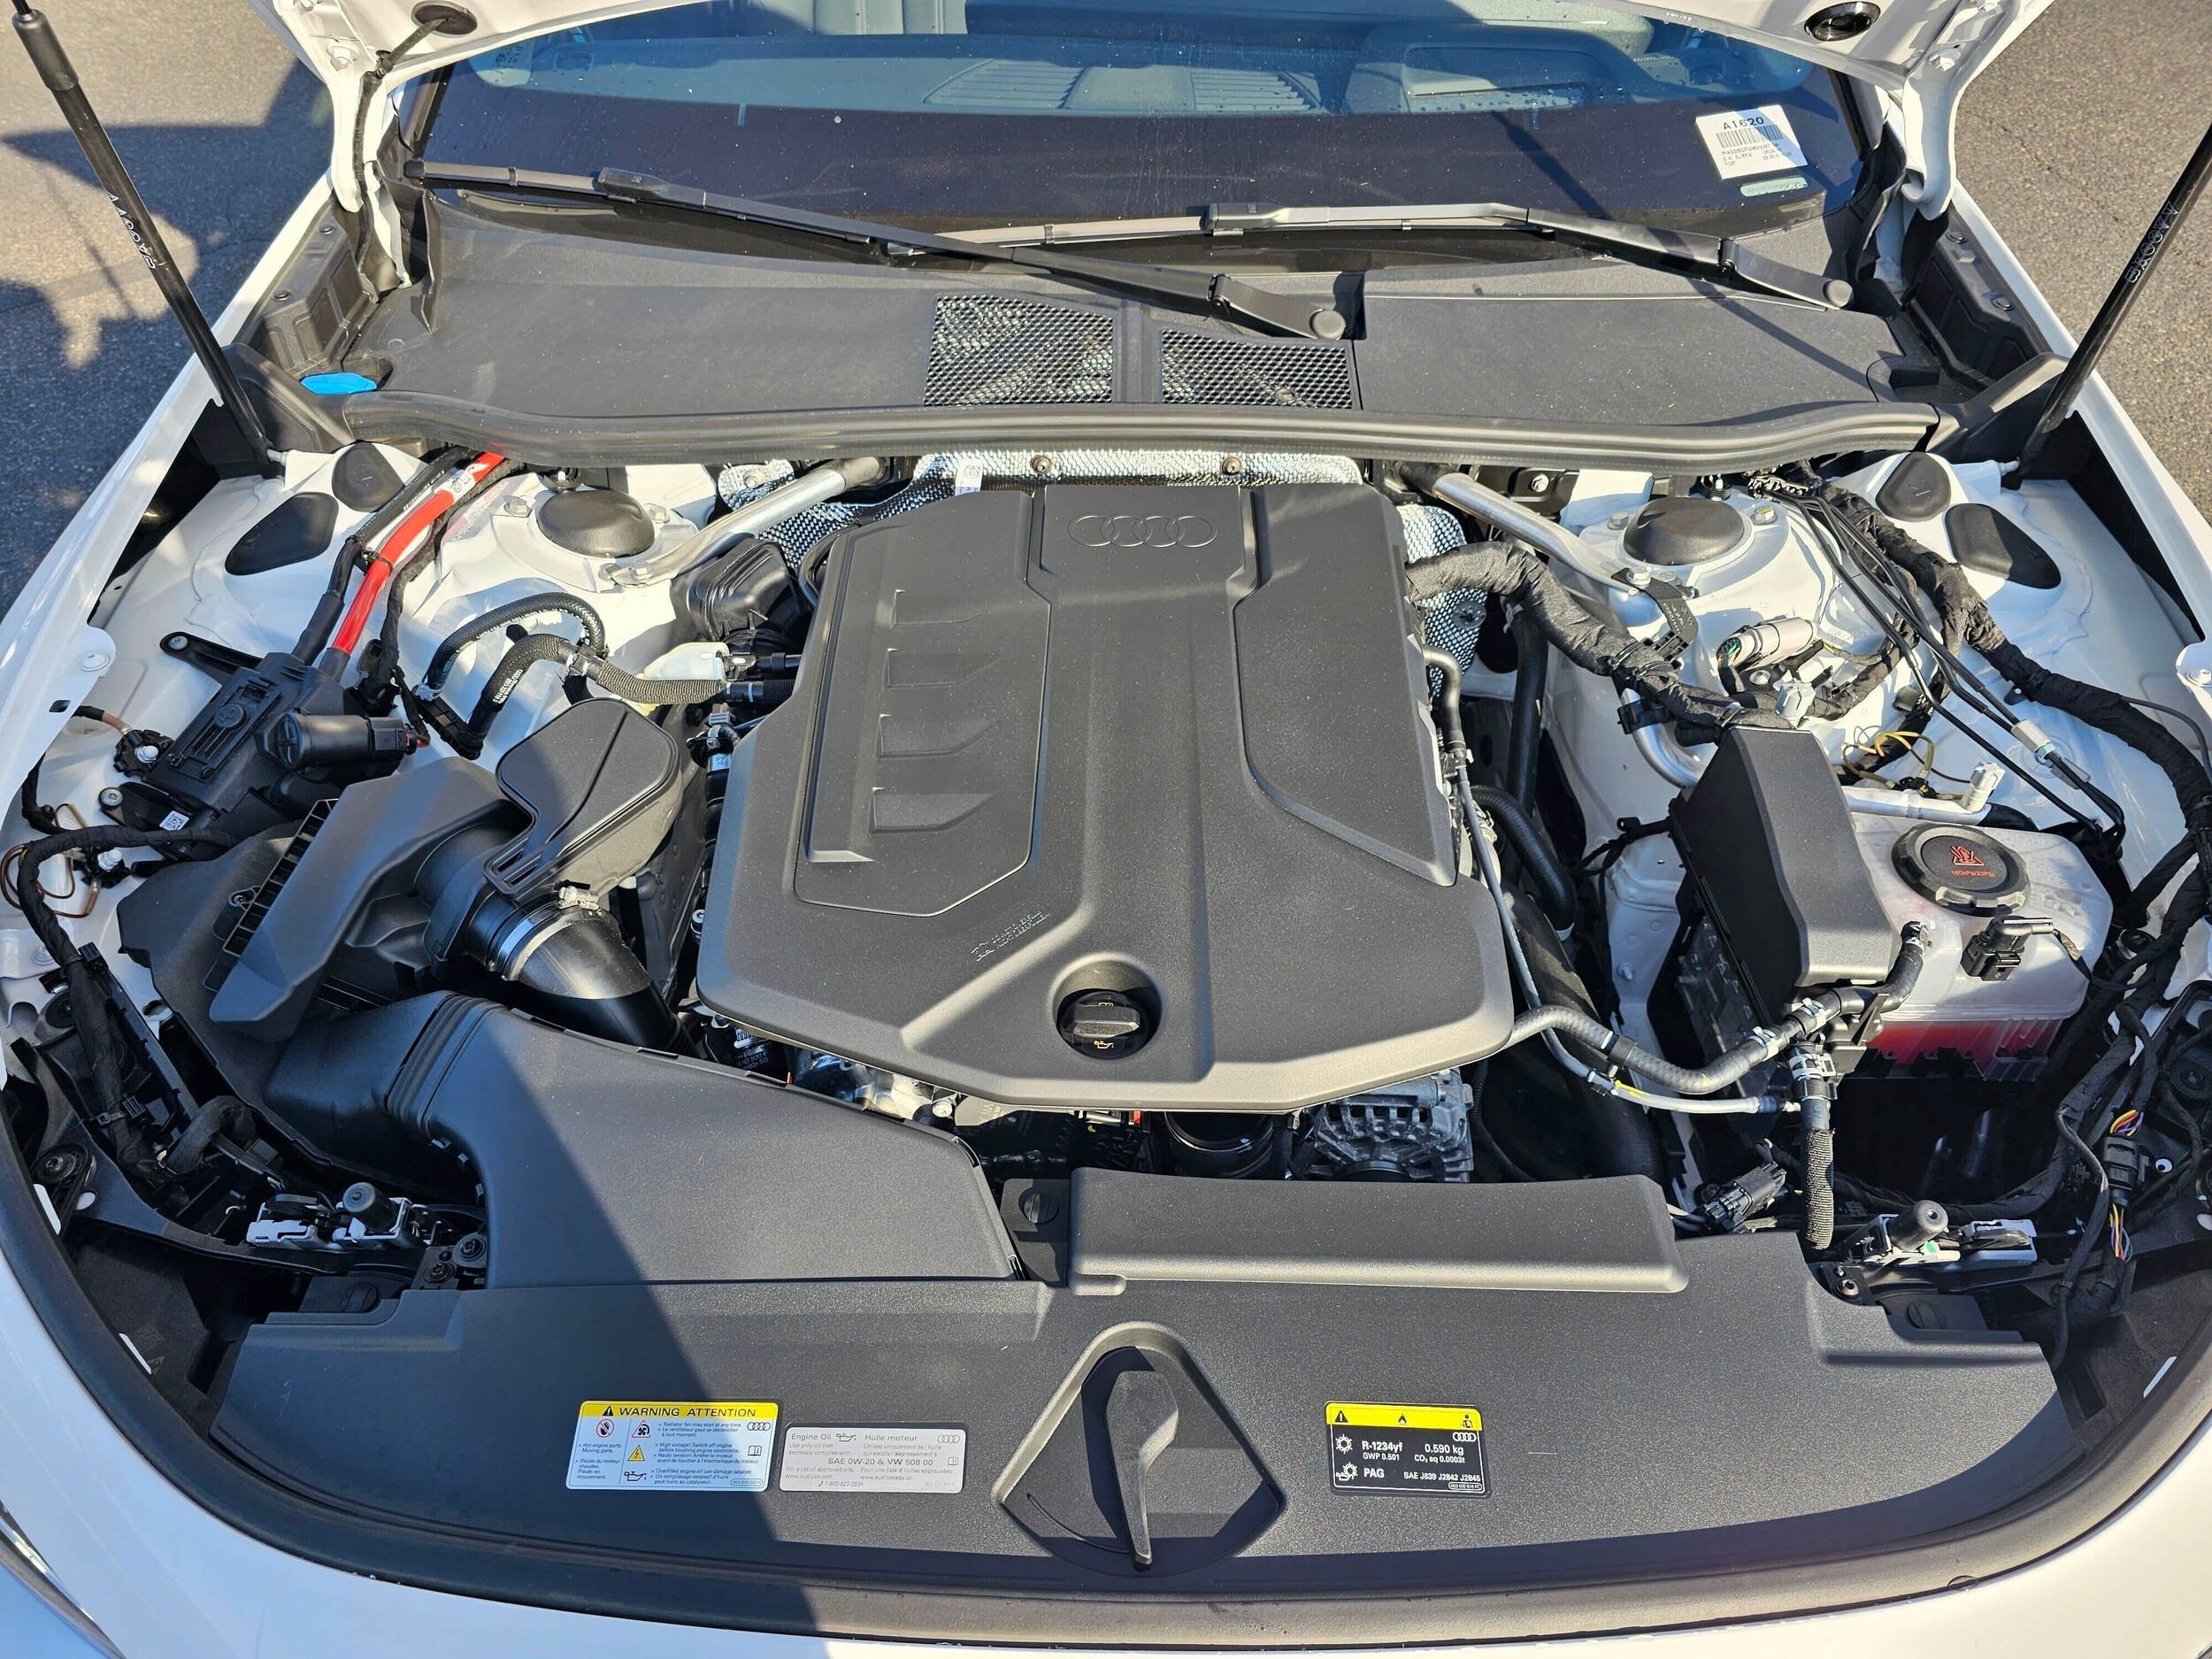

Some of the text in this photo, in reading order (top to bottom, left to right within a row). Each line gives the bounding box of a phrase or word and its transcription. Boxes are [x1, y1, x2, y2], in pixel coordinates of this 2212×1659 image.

[1724, 117, 1764, 130] A1620
[619, 1408, 757, 1417] WARNING ATTENTION
[791, 1432, 818, 1441] Engine
[1362, 1440, 1464, 1455] R-1234yf 0.590 kg
[1363, 1468, 1385, 1479] PAG
[1438, 1472, 1459, 1481] J2842
